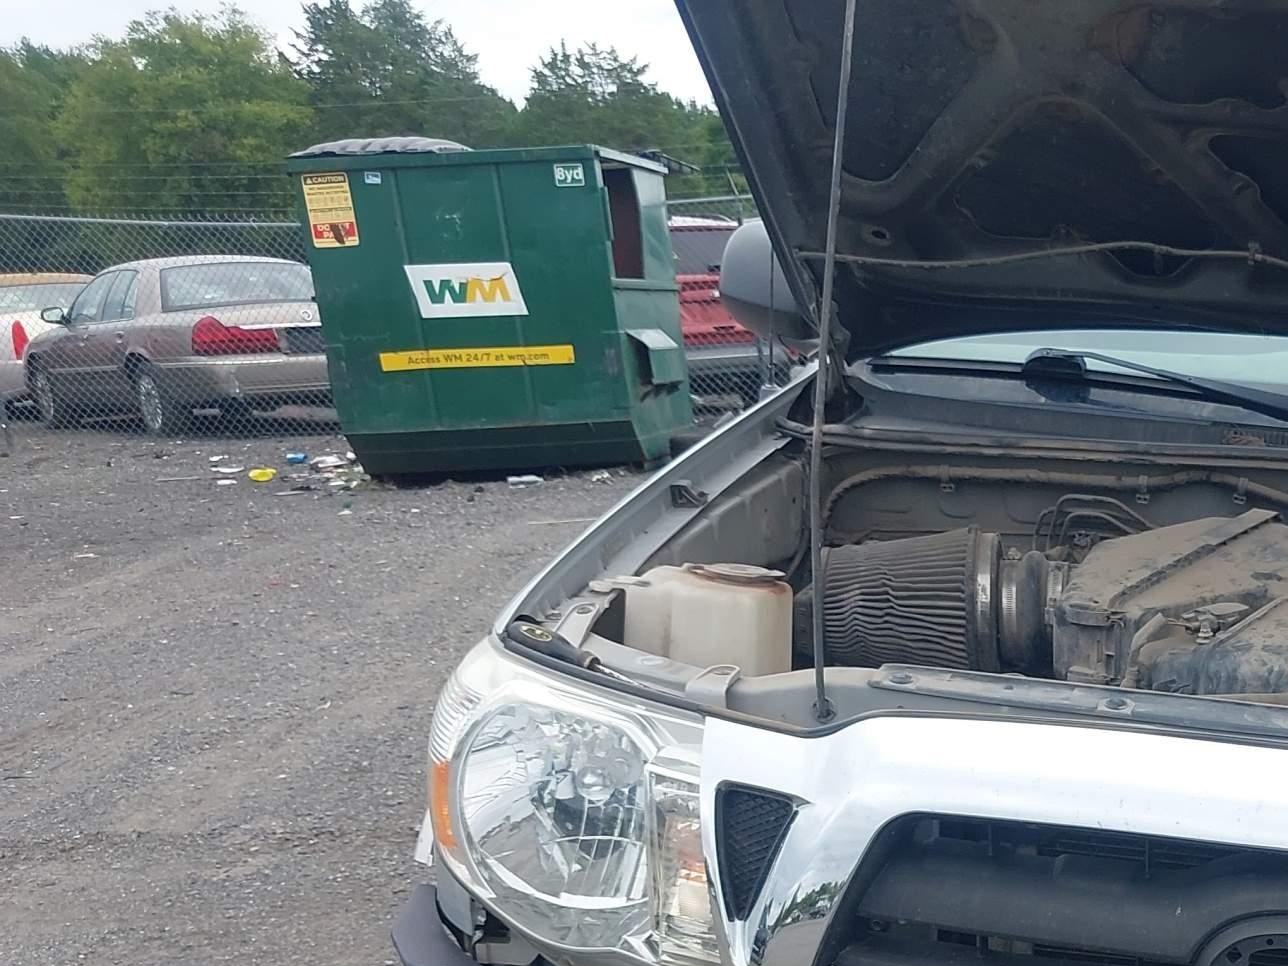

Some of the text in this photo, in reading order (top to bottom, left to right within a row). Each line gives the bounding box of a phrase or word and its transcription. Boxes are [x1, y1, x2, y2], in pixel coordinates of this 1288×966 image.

[422, 277, 512, 305] WM
[407, 352, 550, 365] Access WM 24/7 at wm.com
